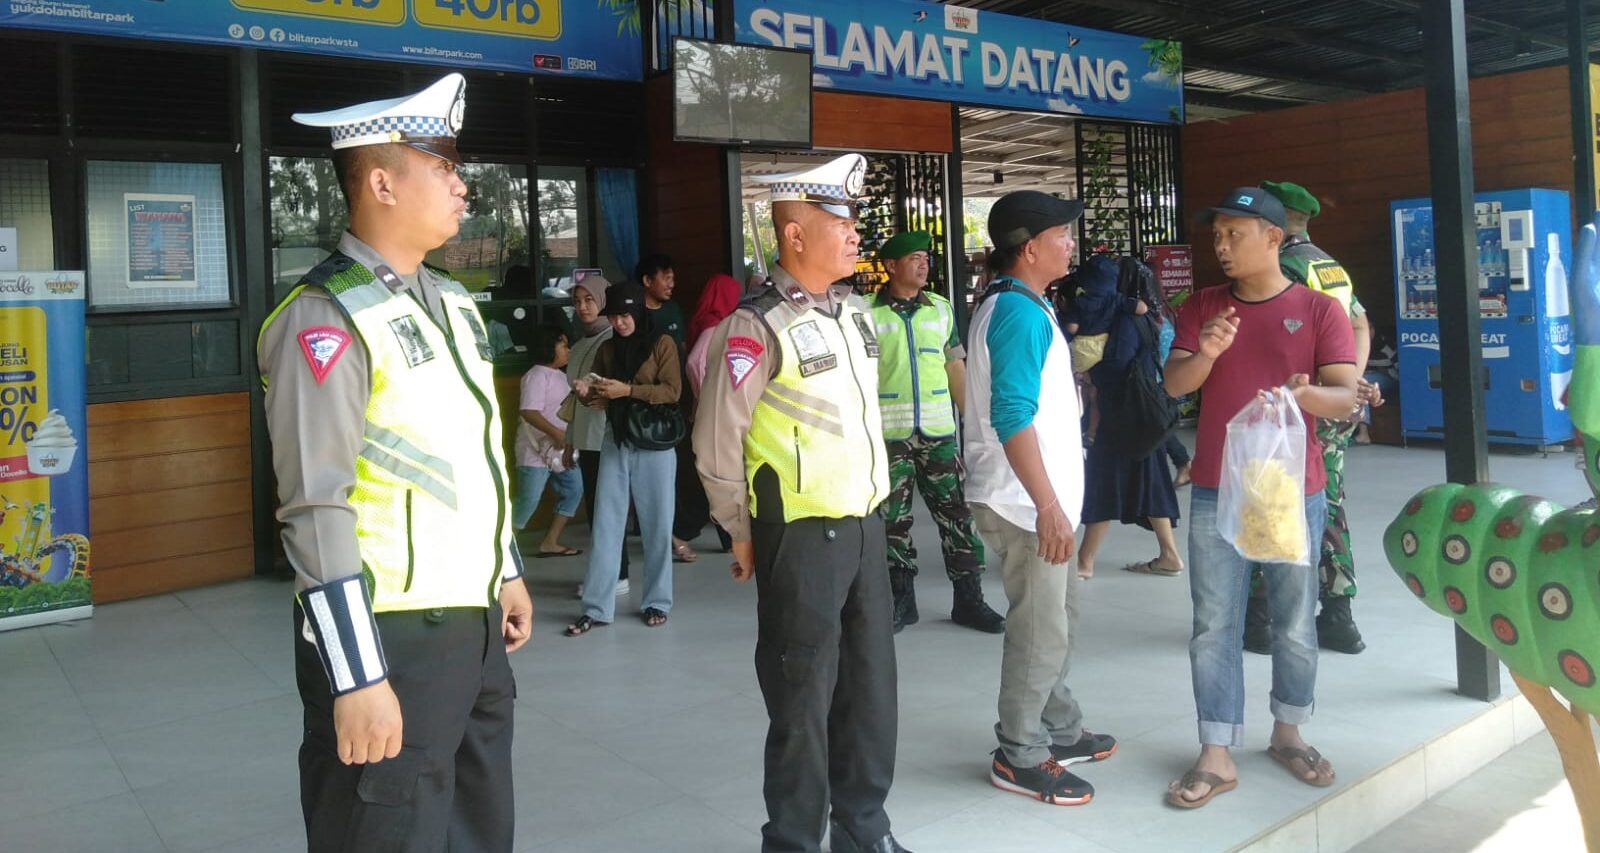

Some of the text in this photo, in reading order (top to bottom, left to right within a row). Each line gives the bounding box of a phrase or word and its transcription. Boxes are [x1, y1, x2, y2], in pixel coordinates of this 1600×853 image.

[10, 4, 135, 23] yukdolanblitarpark
[289, 32, 359, 47] blitarparkwsta
[402, 45, 483, 59] www.blitarpark.com
[750, 8, 1131, 101] SELAMAT DATANG
[579, 58, 597, 71] BRI
[1401, 332, 1507, 344] POCA EAT
[0, 347, 27, 358] ELI
[0, 385, 37, 406] ON
